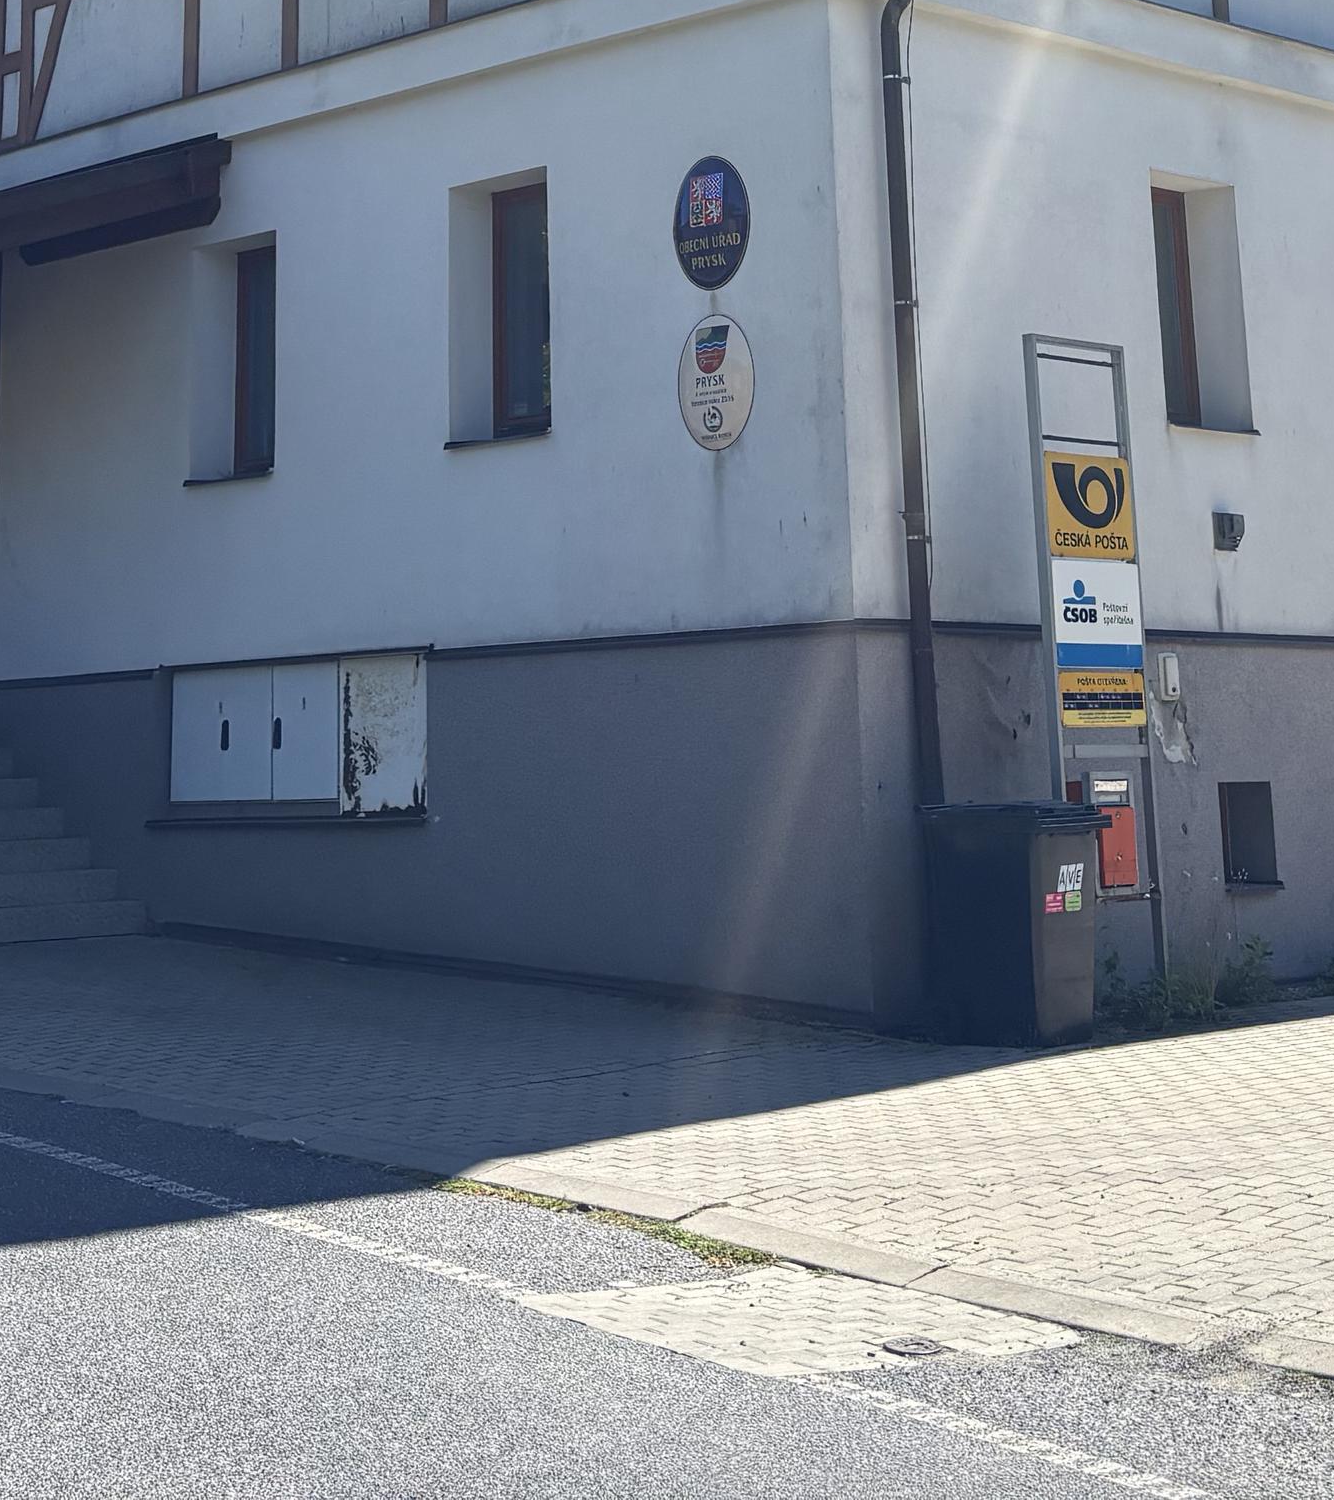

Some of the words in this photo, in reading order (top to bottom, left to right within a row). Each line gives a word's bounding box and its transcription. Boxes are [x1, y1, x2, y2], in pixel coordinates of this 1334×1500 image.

[691, 252, 726, 270] PRYSK
[695, 374, 725, 389] PRYSK
[1054, 528, 1091, 548] ČESKÁ
[1095, 532, 1129, 550] POŠTA
[1063, 605, 1097, 623] ČSOB
[1059, 868, 1083, 886] AVE
